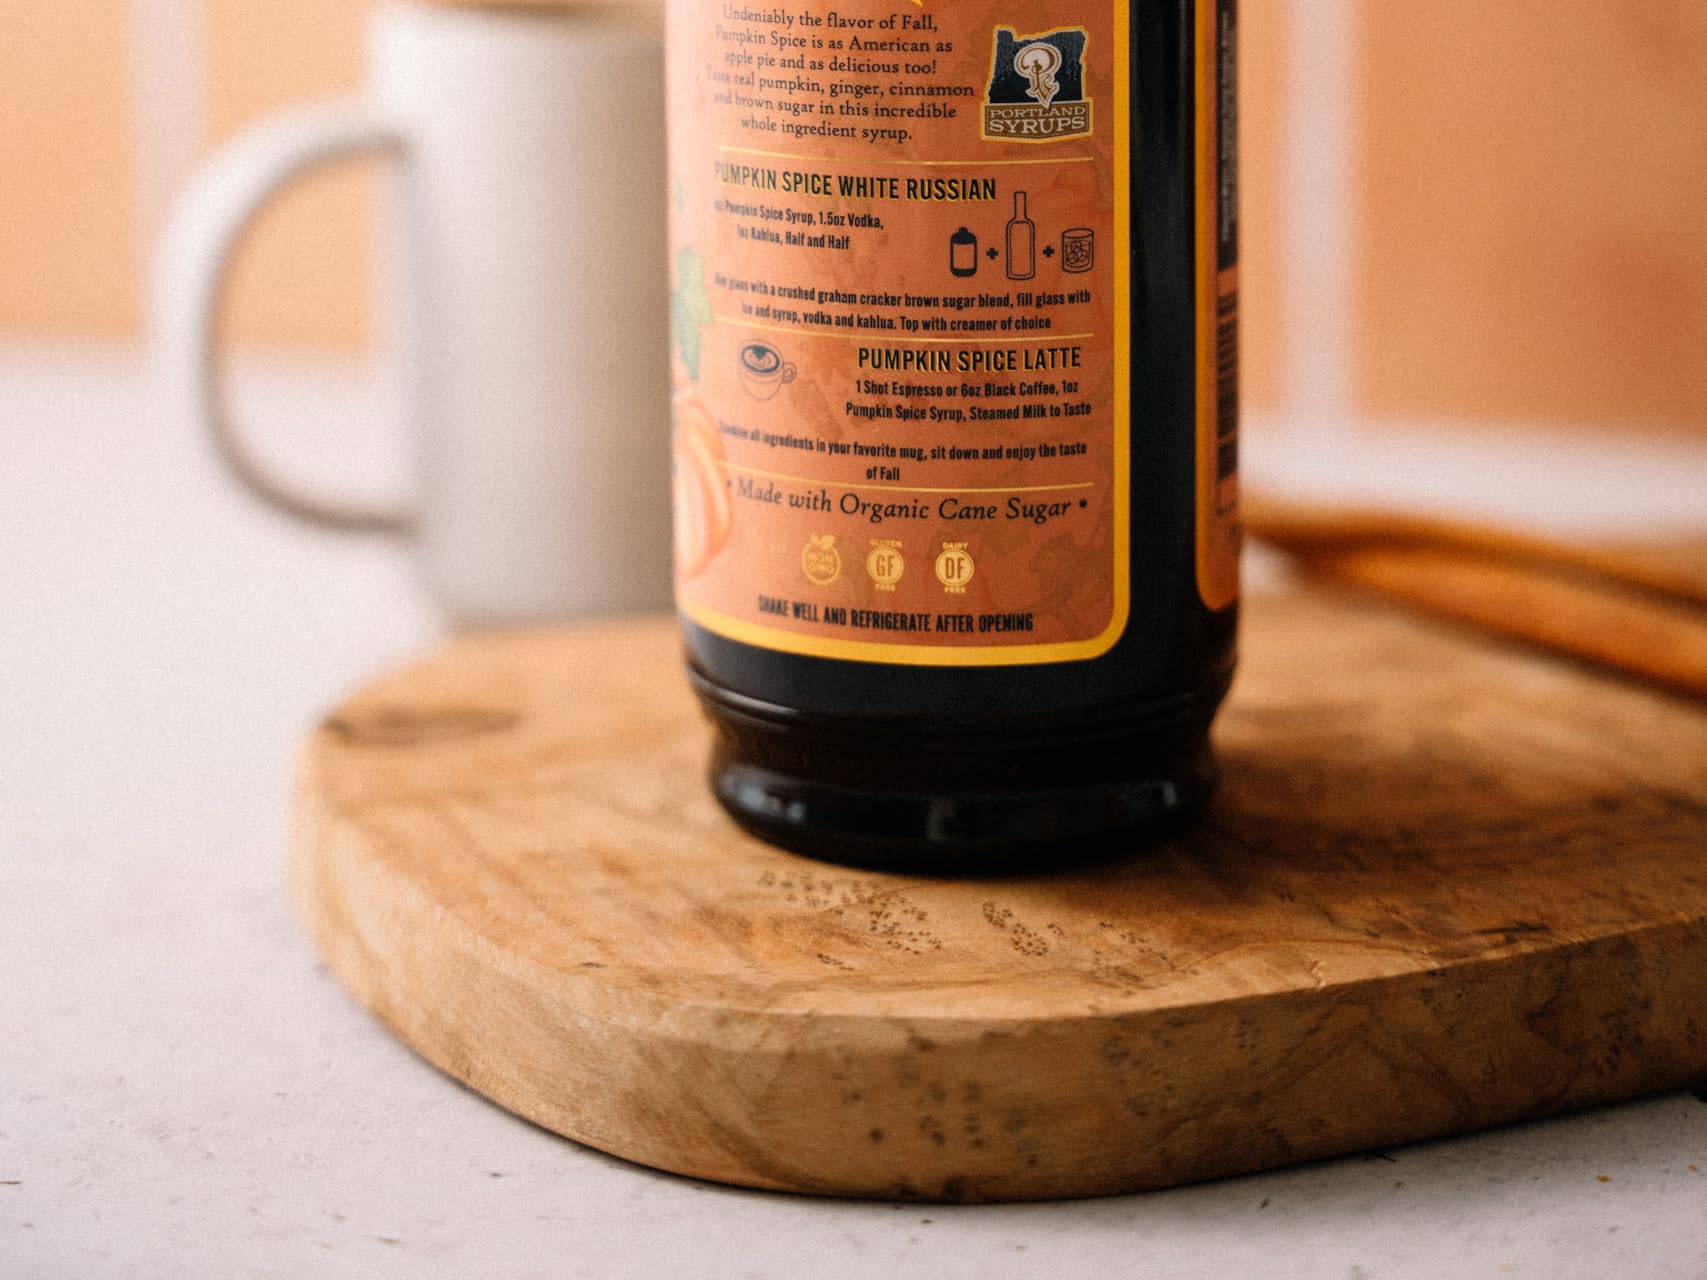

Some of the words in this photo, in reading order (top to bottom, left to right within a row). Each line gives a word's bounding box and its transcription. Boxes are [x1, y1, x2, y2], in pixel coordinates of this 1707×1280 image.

[723, 4, 794, 33] Undeniably
[799, 10, 823, 26] the
[827, 12, 874, 29] flavor
[879, 14, 898, 30] of
[901, 15, 938, 32] Fall,
[715, 25, 766, 47] Pumpkin
[770, 31, 806, 52] Spice
[812, 35, 823, 49] is
[828, 40, 843, 50] as
[849, 37, 930, 52] American
[936, 41, 952, 52] as
[724, 49, 753, 68] apple
[757, 54, 776, 69] pie
[780, 54, 804, 70] and
[809, 60, 824, 71] as
[829, 57, 899, 74] delicious
[904, 59, 937, 74] too!
[734, 73, 755, 87] real
[759, 75, 825, 97] pumpkin,
[829, 82, 884, 98] ginger,
[889, 82, 974, 96] cinnamon
[735, 90, 773, 109] brown
[778, 99, 814, 116] sugar
[819, 99, 834, 115] in
[839, 103, 869, 117] this
[874, 103, 957, 118] incredible
[989, 106, 1086, 119] PORTLAND
[740, 116, 777, 131] whole
[781, 118, 856, 138] ingredient
[862, 127, 912, 143] syrup.
[989, 116, 1085, 135] SYRUPS
[714, 161, 776, 191] PUMPKIN
[782, 171, 832, 195] SPICE
[838, 175, 899, 199] WHITE
[906, 178, 996, 201] RUSSIAN
[760, 205, 784, 221] Spice
[785, 208, 816, 226] Syrup,
[819, 211, 845, 226] 1.5oz
[847, 213, 884, 230] Vodka,
[751, 226, 782, 245] Kahlua,
[785, 231, 805, 247] Half
[807, 233, 825, 248] and
[828, 235, 850, 250] Half
[751, 280, 768, 295] with
[770, 287, 775, 296] a
[777, 286, 815, 302] crushed
[818, 289, 857, 305] graham
[860, 292, 902, 307] cracker
[905, 293, 939, 308] brown
[942, 295, 975, 310] sugar
[978, 293, 1013, 309] blend,
[1016, 292, 1032, 307] fill
[1036, 291, 1065, 308] glass
[1068, 289, 1091, 305] with
[755, 305, 770, 318] and
[773, 308, 800, 324] syrup,
[803, 311, 832, 325] vodka
[835, 313, 854, 328] and
[857, 314, 897, 330] kahlua.
[900, 317, 918, 332] Top
[922, 317, 947, 331] with
[950, 320, 996, 331] creamer
[1000, 316, 1012, 330] of
[1015, 315, 1051, 330] choice
[857, 348, 950, 372] PUMPKIN
[957, 350, 1017, 372] SPICE
[1023, 347, 1081, 370] LATTE
[856, 380, 861, 393] 1
[864, 381, 889, 395] Shot
[892, 382, 943, 398] Espresso
[946, 386, 958, 397] or
[961, 384, 981, 397] 6oz
[985, 383, 1016, 397] Black
[1019, 382, 1059, 397] Coffee,
[1062, 380, 1079, 394] 1oz
[846, 402, 893, 420] Pumpkin
[896, 405, 926, 422] Spice
[930, 406, 966, 423] Syrup,
[970, 405, 1019, 421] Steamed
[1023, 403, 1047, 419] Milk
[1050, 403, 1061, 418] to
[1063, 402, 1092, 417] Taste
[763, 431, 814, 451] ingredients
[817, 438, 826, 453] in
[828, 443, 852, 456] your
[853, 441, 897, 458] favorite
[900, 447, 928, 462] mug,
[931, 446, 946, 460] sit
[949, 446, 979, 460] down
[982, 446, 1003, 460] and
[1006, 445, 1036, 461] enjoy
[1039, 444, 1057, 457] the
[1059, 442, 1087, 456] taste
[866, 466, 878, 480] of
[880, 466, 900, 481] Fall
[736, 477, 782, 505] Made
[788, 489, 832, 512] with
[839, 493, 930, 524] Organic
[938, 498, 997, 520] Cane
[1005, 497, 1072, 525] Sugar
[942, 542, 969, 550] DAIRY
[876, 554, 895, 577] GF
[944, 557, 965, 580] DF
[792, 602, 819, 623] WELL
[824, 606, 847, 626] AND
[851, 609, 931, 632] REFRIGERATE
[935, 613, 974, 633] AFTER
[978, 612, 1034, 632] OPENING
